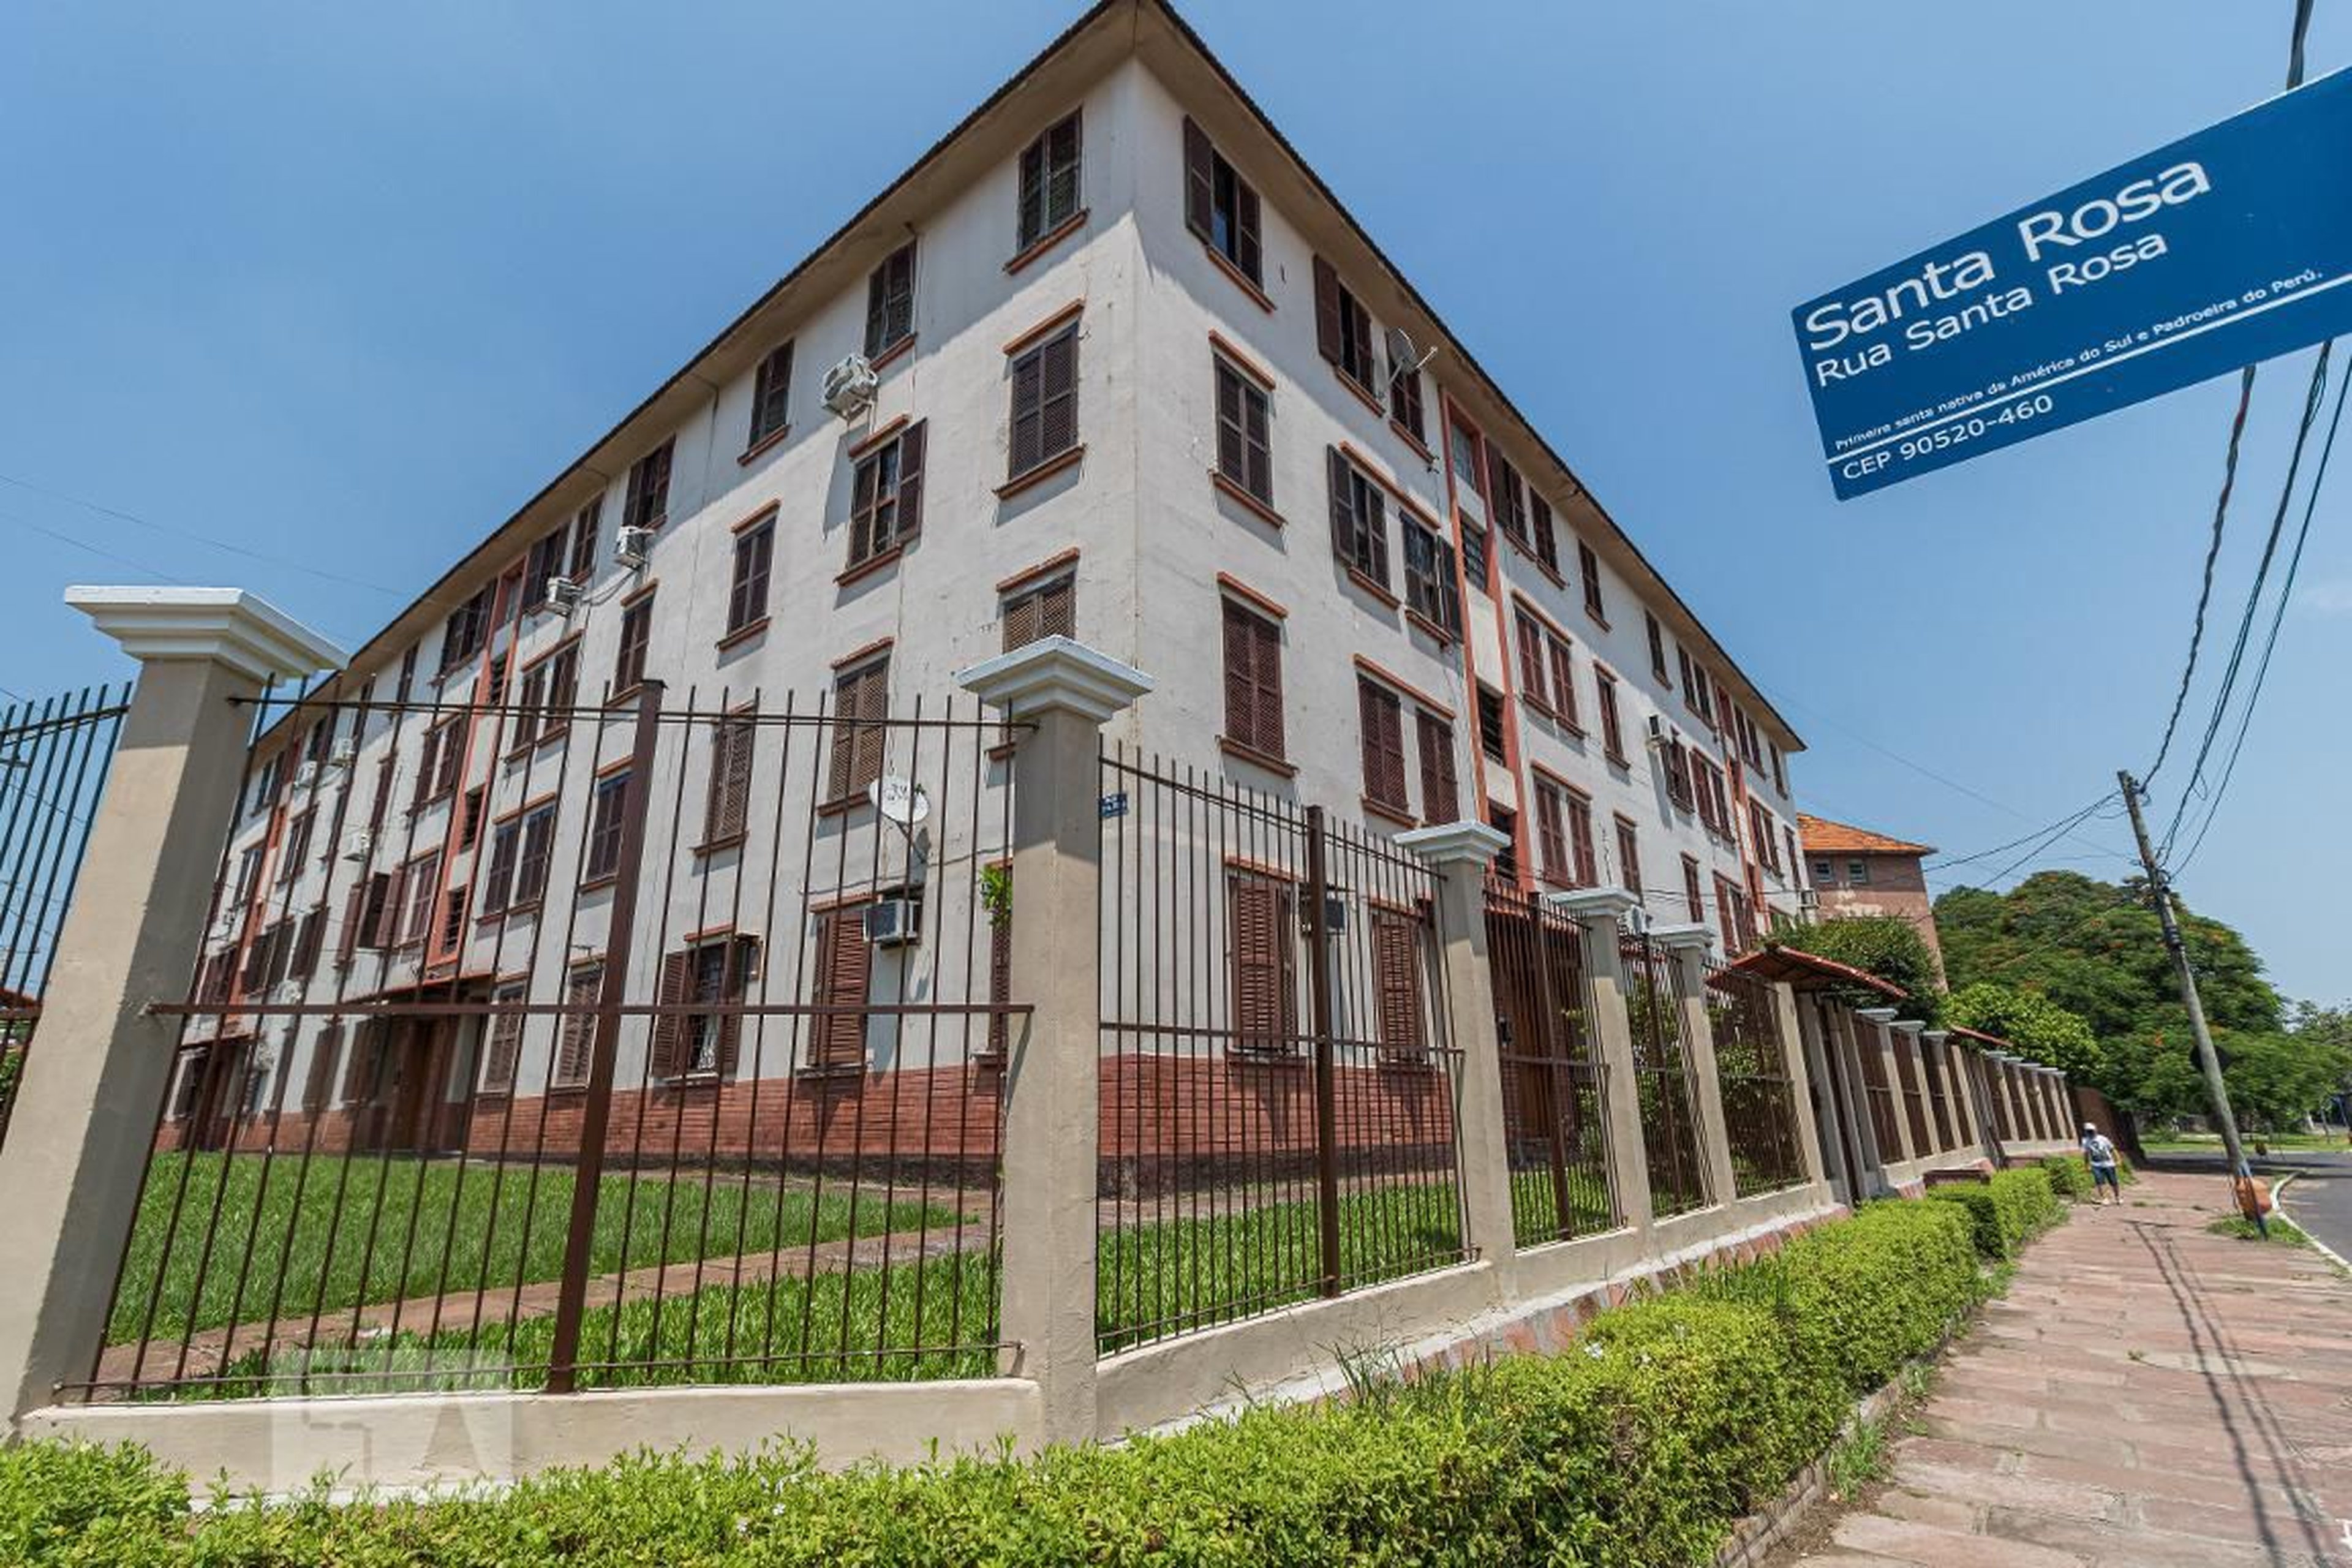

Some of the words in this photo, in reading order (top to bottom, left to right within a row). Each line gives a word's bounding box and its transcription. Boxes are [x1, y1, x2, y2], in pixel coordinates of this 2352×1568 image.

[1806, 251, 1996, 350] Santa
[2018, 161, 2211, 262] Rosa
[1816, 343, 1892, 387] Rua
[1905, 287, 2033, 352] Santa
[2047, 234, 2168, 295] Rosa
[1894, 408, 1934, 428] santa
[1937, 391, 1984, 413] nativa
[1987, 382, 2007, 396] da
[2011, 358, 2075, 386] América
[2079, 347, 2100, 362] do
[2104, 334, 2133, 353] Sul
[2136, 331, 2148, 341] e
[2152, 300, 2238, 335] Padroeira
[2242, 288, 2267, 304] do
[1842, 451, 1891, 480] CEP
[1899, 394, 2054, 461] 90520-460
